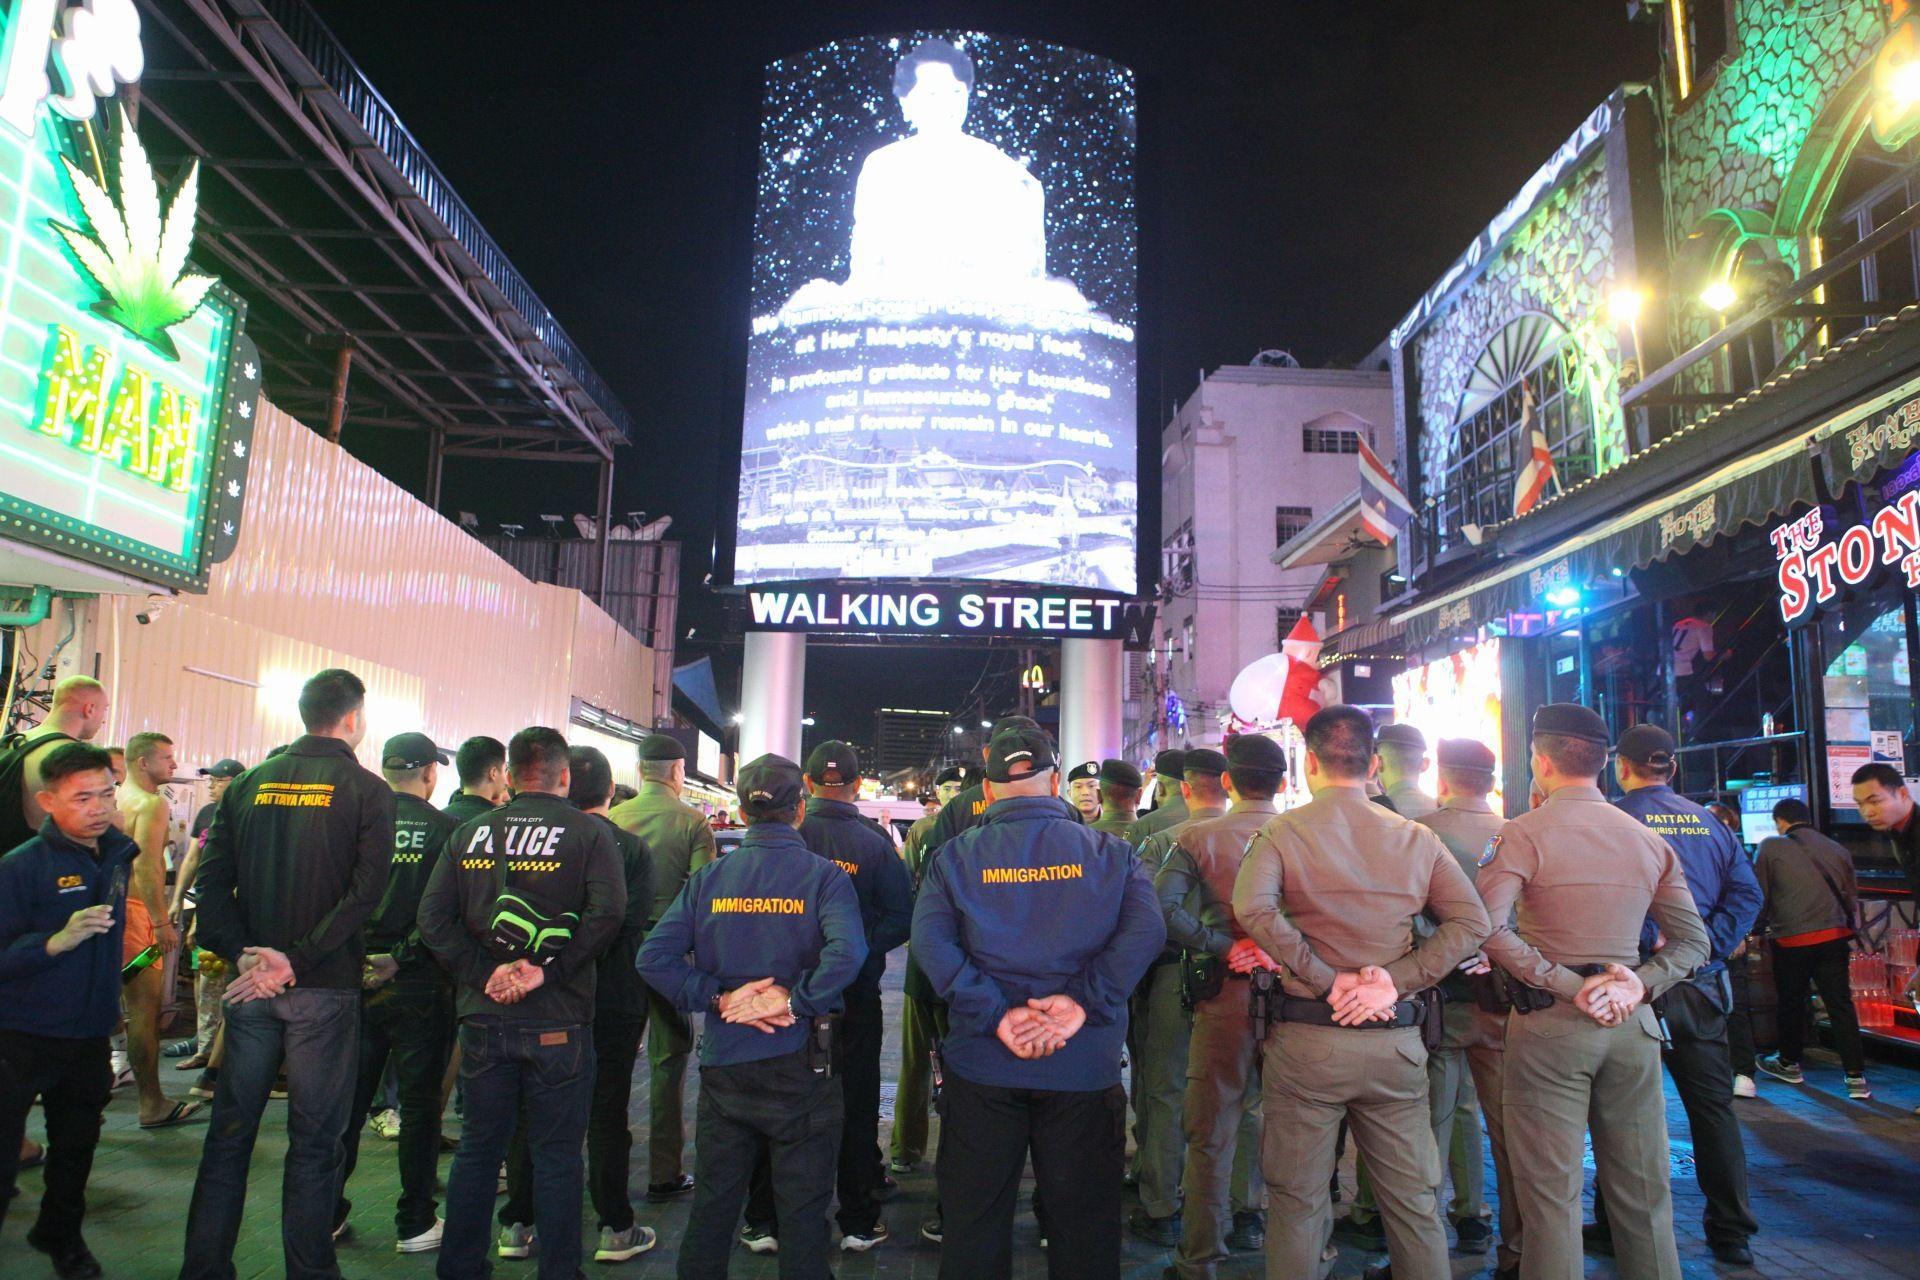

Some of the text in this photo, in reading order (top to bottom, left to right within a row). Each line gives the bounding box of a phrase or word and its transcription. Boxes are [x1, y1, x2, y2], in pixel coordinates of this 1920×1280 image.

[795, 336, 815, 354] at
[822, 331, 859, 350] Her
[866, 326, 972, 348] Majesty's
[979, 332, 1034, 352] royal
[789, 364, 863, 392] profound
[868, 362, 950, 385] gratitude
[956, 364, 984, 382] for
[989, 366, 1024, 384] Her
[1028, 369, 1111, 399] boundless
[38, 323, 201, 494] MAN
[825, 390, 858, 408] and
[863, 389, 991, 406] immeasurable
[766, 420, 811, 440] which
[815, 414, 855, 434] shall
[860, 414, 925, 430] forever
[930, 414, 994, 432] remain
[1001, 416, 1018, 434] in
[1024, 422, 1055, 437] our
[1770, 506, 1824, 560] THE
[1778, 490, 1920, 623] STON
[750, 592, 1121, 631] WALKING STREET
[254, 792, 333, 807] PATTAYA POLICE
[1645, 813, 1701, 824] PATTAYA
[1680, 827, 1711, 836] POLICE
[982, 863, 1083, 884] IMMIGRATION
[711, 897, 804, 914] IMMIGRATION
